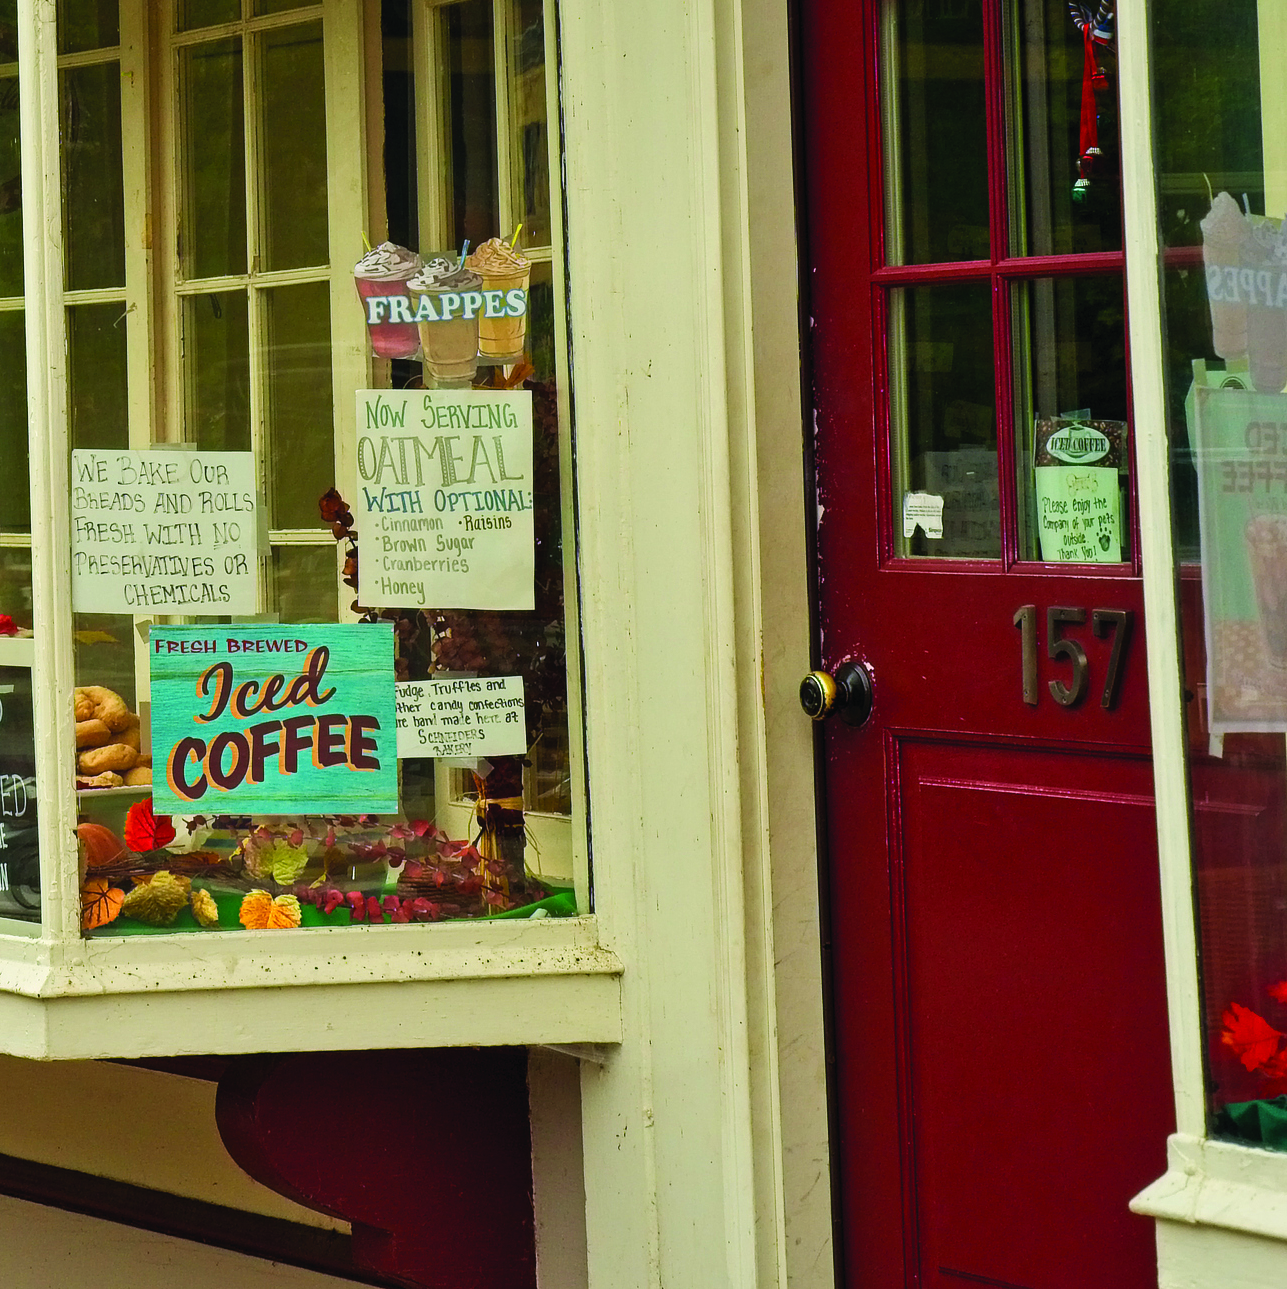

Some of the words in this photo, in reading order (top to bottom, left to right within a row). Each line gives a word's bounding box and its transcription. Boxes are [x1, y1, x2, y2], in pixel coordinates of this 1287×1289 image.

[365, 288, 528, 325] FRAPPES
[365, 395, 407, 429] NOW
[421, 395, 518, 429] SERVING
[1050, 437, 1072, 451] ICED
[1073, 437, 1106, 452] COFFEE
[74, 454, 108, 483] WE
[116, 456, 180, 485] BAKE
[189, 458, 230, 485] OUR
[357, 435, 524, 487] OATMEAL
[153, 492, 192, 514] AND
[198, 491, 254, 514] ROLLS
[362, 487, 423, 513] WITH
[434, 489, 532, 512] OPTIONAL:
[1042, 496, 1068, 515] Please
[1093, 497, 1107, 510] the
[74, 516, 136, 543] FRESH
[143, 523, 202, 545] WITH
[213, 522, 241, 545] NO
[381, 516, 444, 533] Cinnamon
[464, 514, 512, 532] Raisins
[1043, 515, 1070, 533] Company
[1072, 516, 1079, 530] of
[1082, 517, 1095, 531] your
[1098, 513, 1115, 527] pets
[382, 535, 427, 553] Brown
[436, 534, 475, 557] Sugar
[1057, 547, 1079, 561] Thank
[74, 551, 215, 578] PRESERVATIVES
[224, 553, 249, 575] OR
[382, 556, 470, 573] Cranberries
[124, 583, 231, 606] CHEMICALS
[381, 576, 426, 605] Honey
[155, 639, 217, 654] FRESH
[227, 638, 308, 653] BREWED
[1013, 604, 1129, 709] 157
[193, 646, 337, 724] Iced
[431, 681, 482, 696] Truffles
[486, 679, 506, 691] and
[396, 702, 422, 713] ther
[430, 699, 463, 713] candy
[476, 712, 501, 725] here
[505, 711, 518, 723] at
[166, 714, 381, 802] COFFEE
[433, 742, 473, 756] BAKERY
